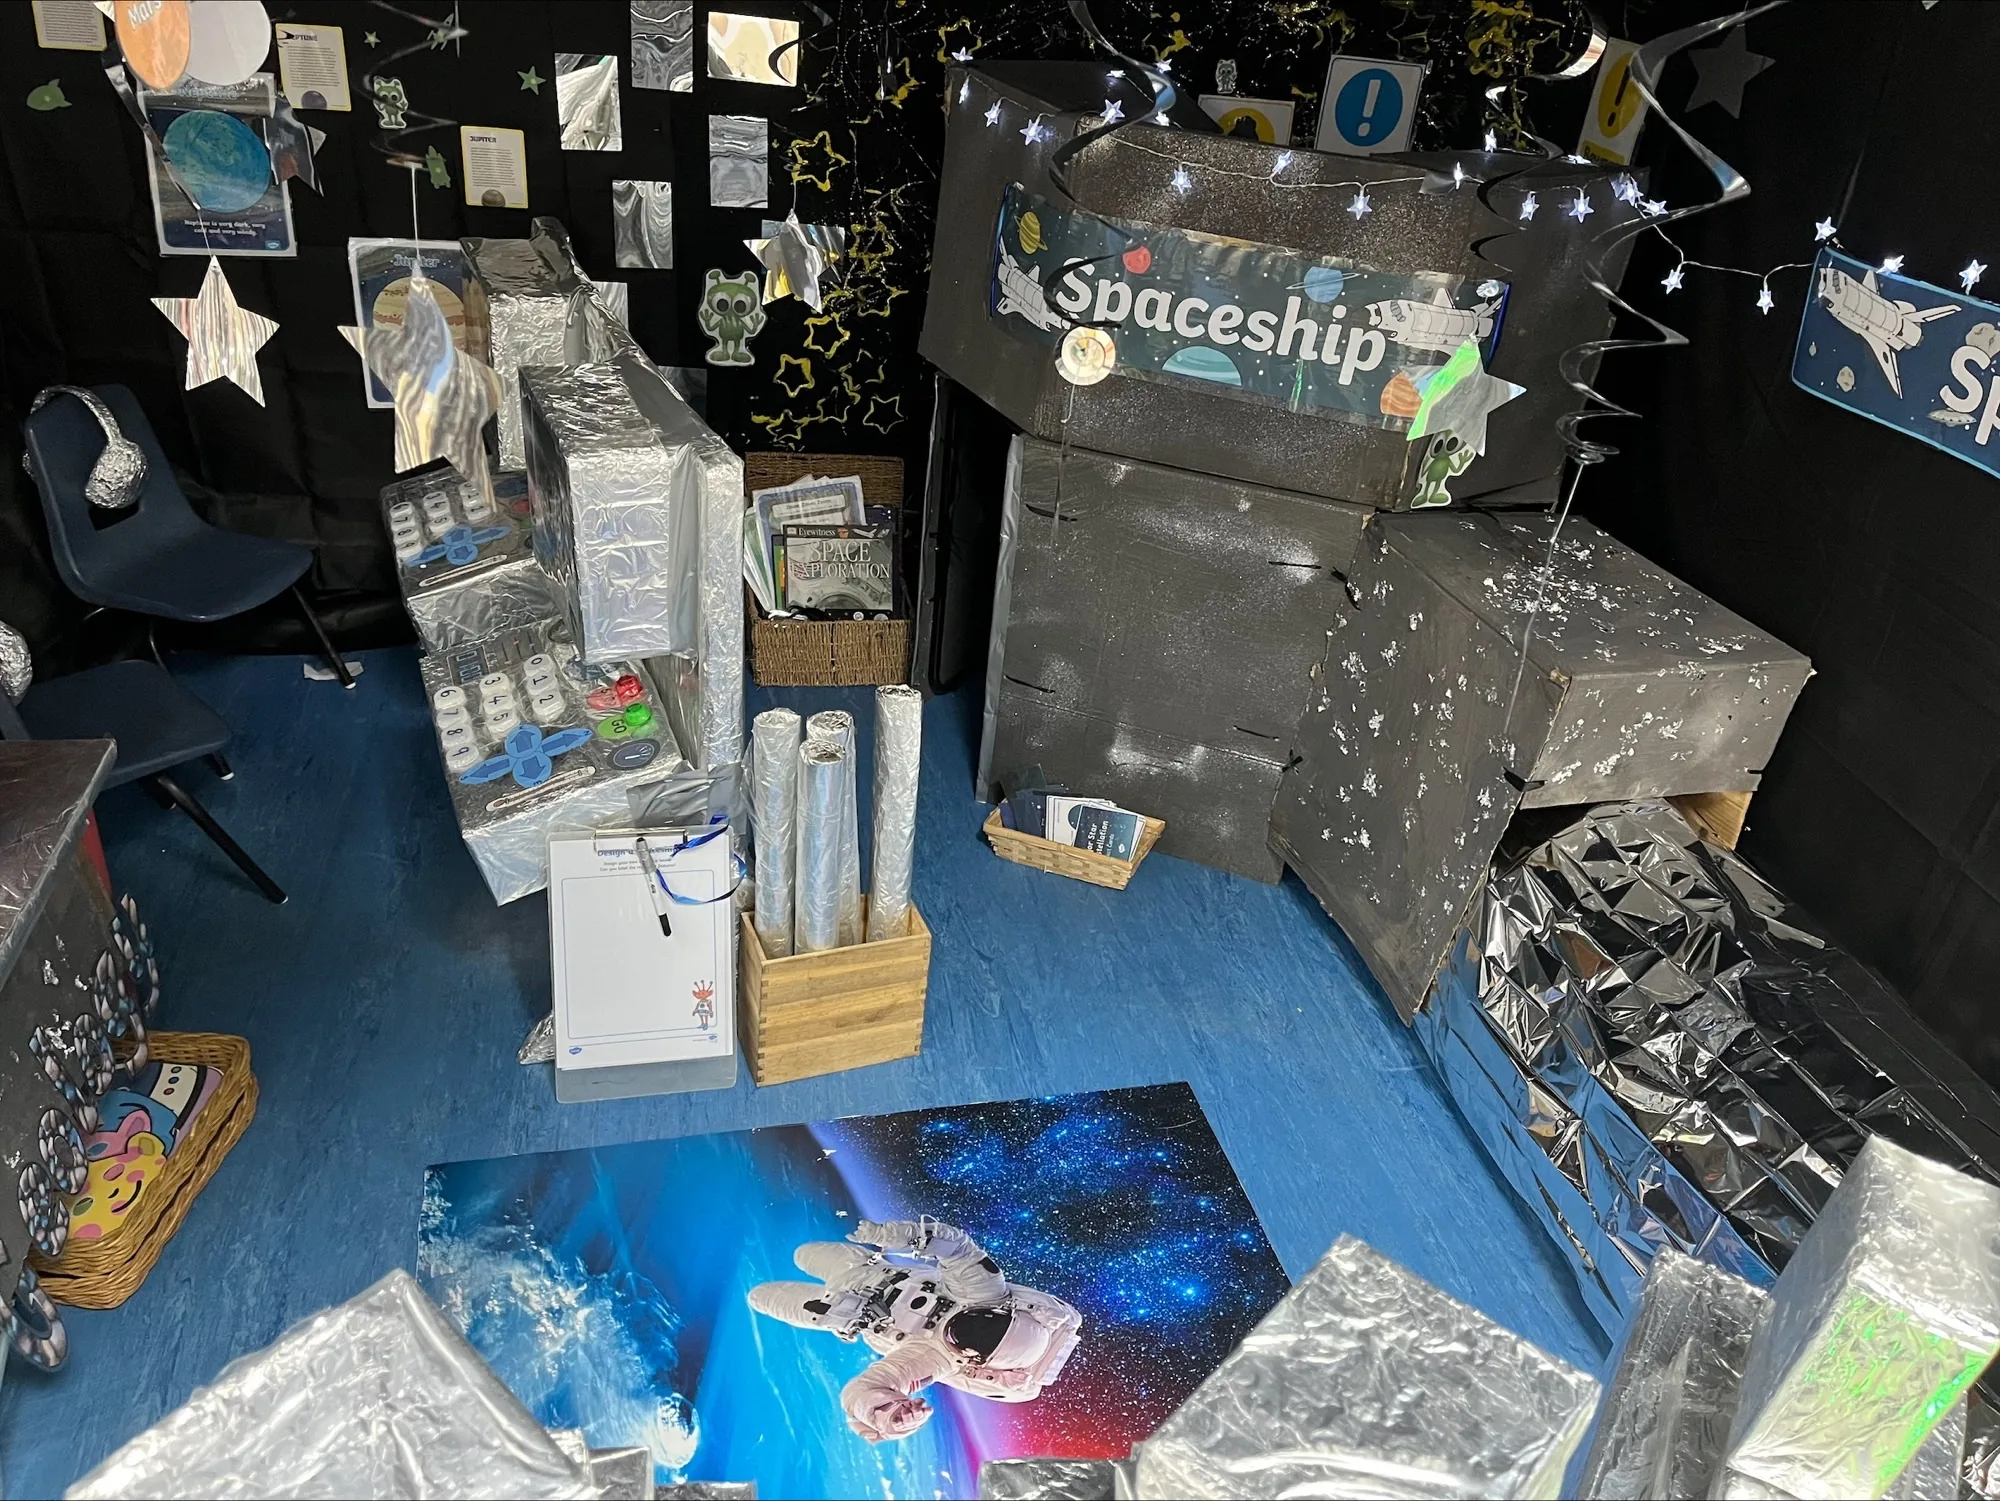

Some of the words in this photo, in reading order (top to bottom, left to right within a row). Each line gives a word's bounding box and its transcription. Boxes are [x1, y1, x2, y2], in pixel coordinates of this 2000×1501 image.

[1054, 256, 1387, 387] Spaceship
[798, 528, 836, 537] Eyewitness
[810, 541, 872, 562] SPACE
[791, 563, 890, 580] EXPLORATION
[488, 695, 507, 705] 4
[446, 728, 464, 736] 8
[611, 719, 628, 734] GO
[1087, 822, 1098, 841] Star
